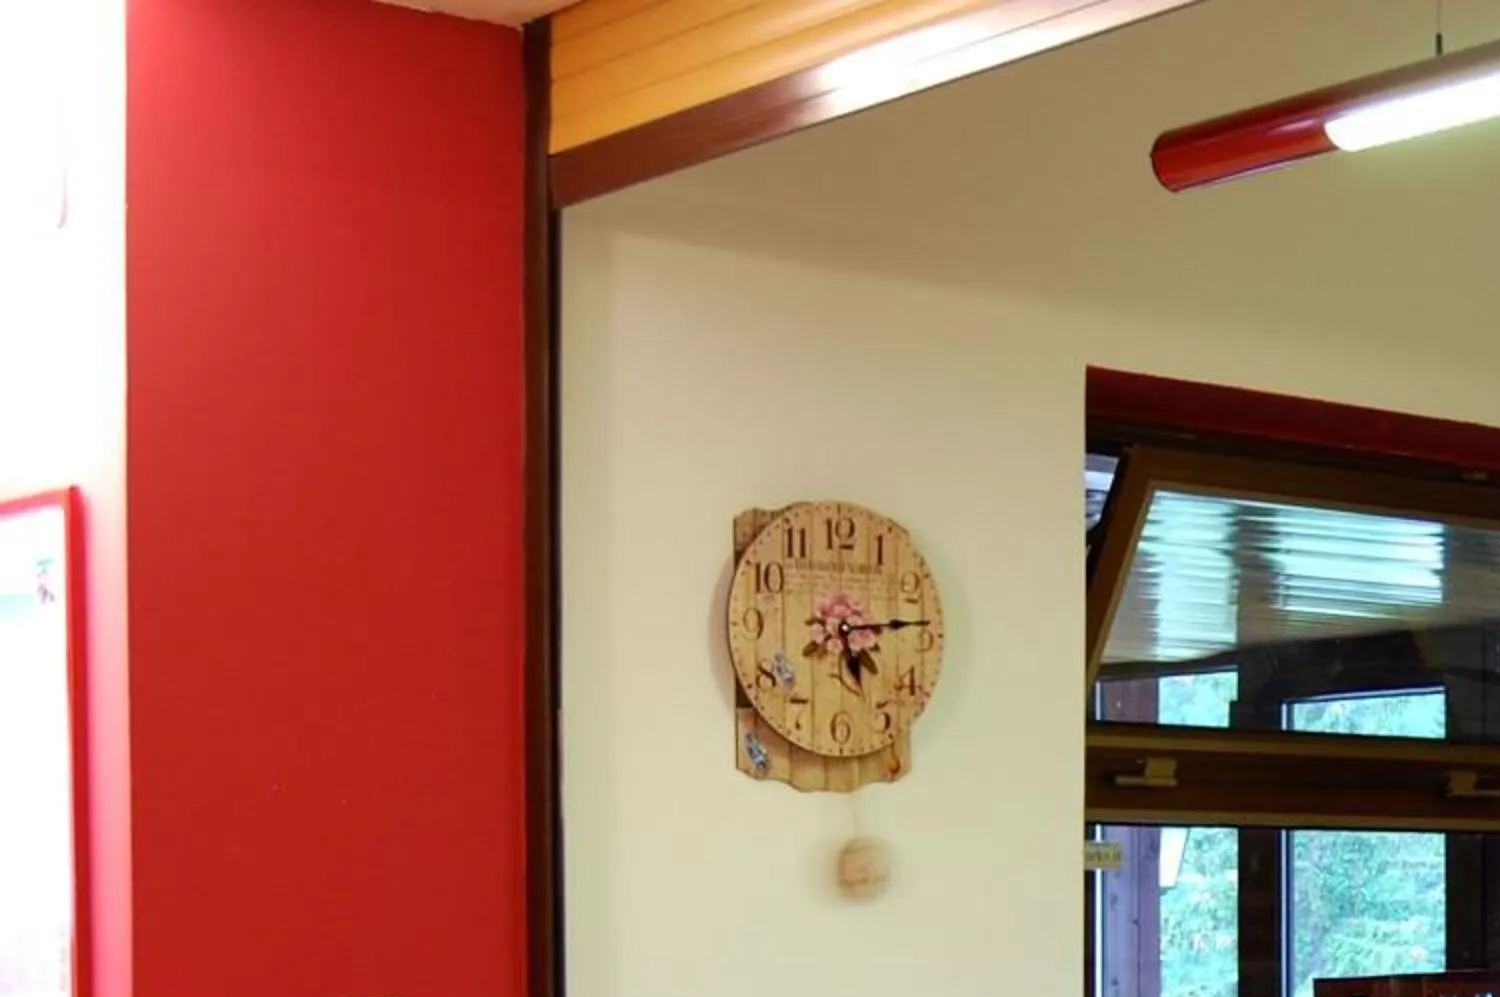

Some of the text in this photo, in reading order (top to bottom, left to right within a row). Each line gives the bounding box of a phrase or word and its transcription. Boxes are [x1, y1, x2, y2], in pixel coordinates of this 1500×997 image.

[786, 527, 807, 559] 11
[824, 517, 855, 550] 12
[876, 535, 884, 567] 1
[754, 562, 784, 594] 10
[743, 608, 764, 641] 9
[756, 658, 777, 693] 8
[895, 666, 921, 697] 4
[789, 698, 809, 731] 7
[830, 711, 851, 744] 6
[872, 701, 891, 734] 5
